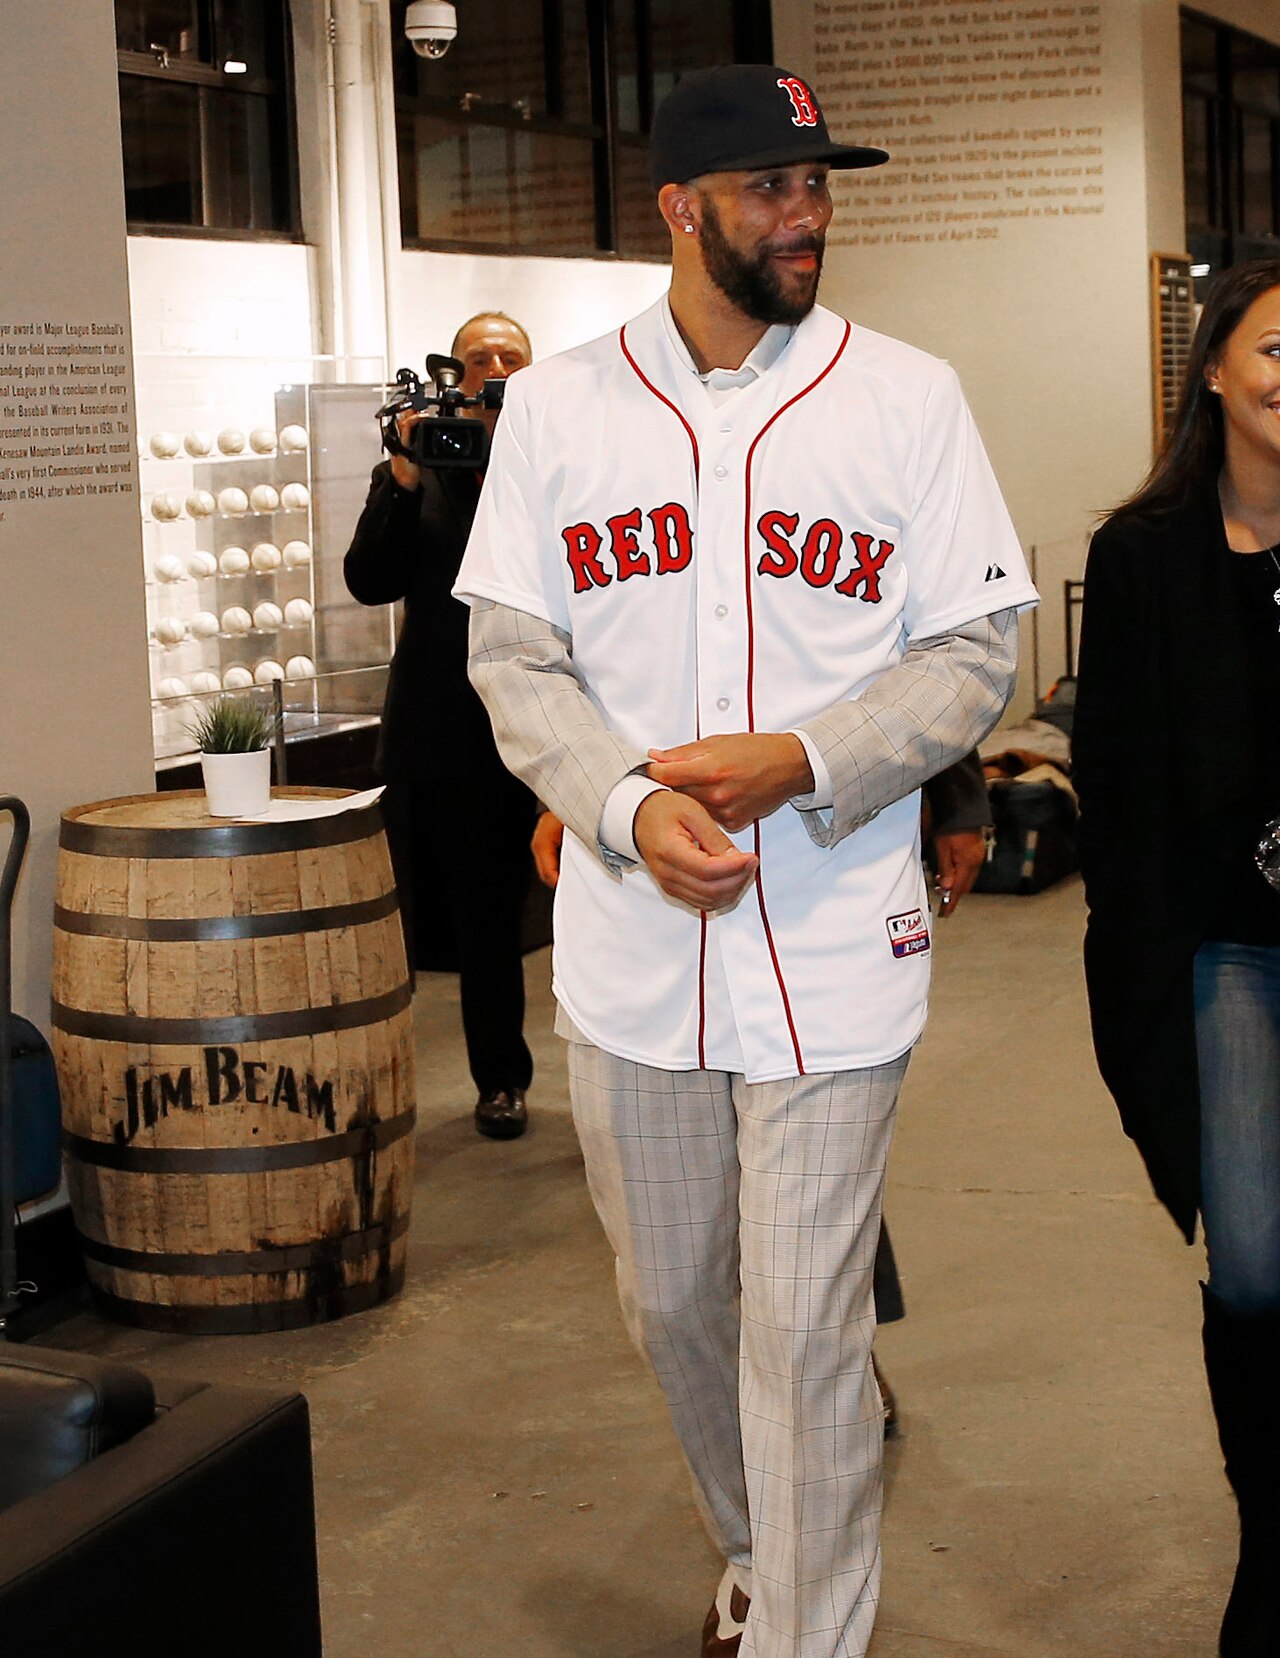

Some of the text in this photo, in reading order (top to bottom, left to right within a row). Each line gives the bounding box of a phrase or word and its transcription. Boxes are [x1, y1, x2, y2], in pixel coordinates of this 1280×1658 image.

[776, 77, 818, 127] B
[14, 323, 34, 335] award
[36, 323, 42, 335] is
[44, 323, 64, 337] Major
[66, 323, 89, 338] League
[92, 323, 124, 335] Baseball's
[6, 343, 16, 355] for
[19, 343, 45, 356] on-field
[47, 343, 102, 357] accomplishments
[103, 344, 117, 355] that
[119, 345, 125, 355] is
[25, 363, 45, 378] player
[48, 365, 54, 376] in
[57, 364, 68, 376] the
[70, 363, 100, 375] American
[102, 363, 125, 377] League
[12, 385, 37, 399] League
[40, 386, 47, 397] at
[49, 384, 60, 396] the
[63, 384, 98, 396] conclusion
[100, 382, 107, 394] of
[109, 385, 126, 397] every
[4, 402, 128, 418] the Baseball Writers Association of
[32, 426, 39, 438] in
[41, 425, 49, 437] its
[50, 426, 74, 437] current
[75, 423, 91, 435] form
[92, 425, 98, 435] in
[117, 421, 129, 433] The
[30, 445, 61, 458] Mountain
[62, 443, 84, 456] Landis
[109, 441, 130, 454] named
[16, 468, 31, 481] very
[32, 465, 47, 478] first
[48, 464, 93, 477] Commissioner
[95, 462, 109, 474] who
[110, 460, 131, 474] served
[20, 489, 26, 499] in
[48, 485, 64, 498] after
[65, 483, 84, 496] which
[86, 482, 97, 495] the
[99, 481, 118, 494] award
[120, 483, 132, 493] was
[561, 502, 895, 604] RED SOX
[112, 1046, 337, 1147] JIM BEAM
